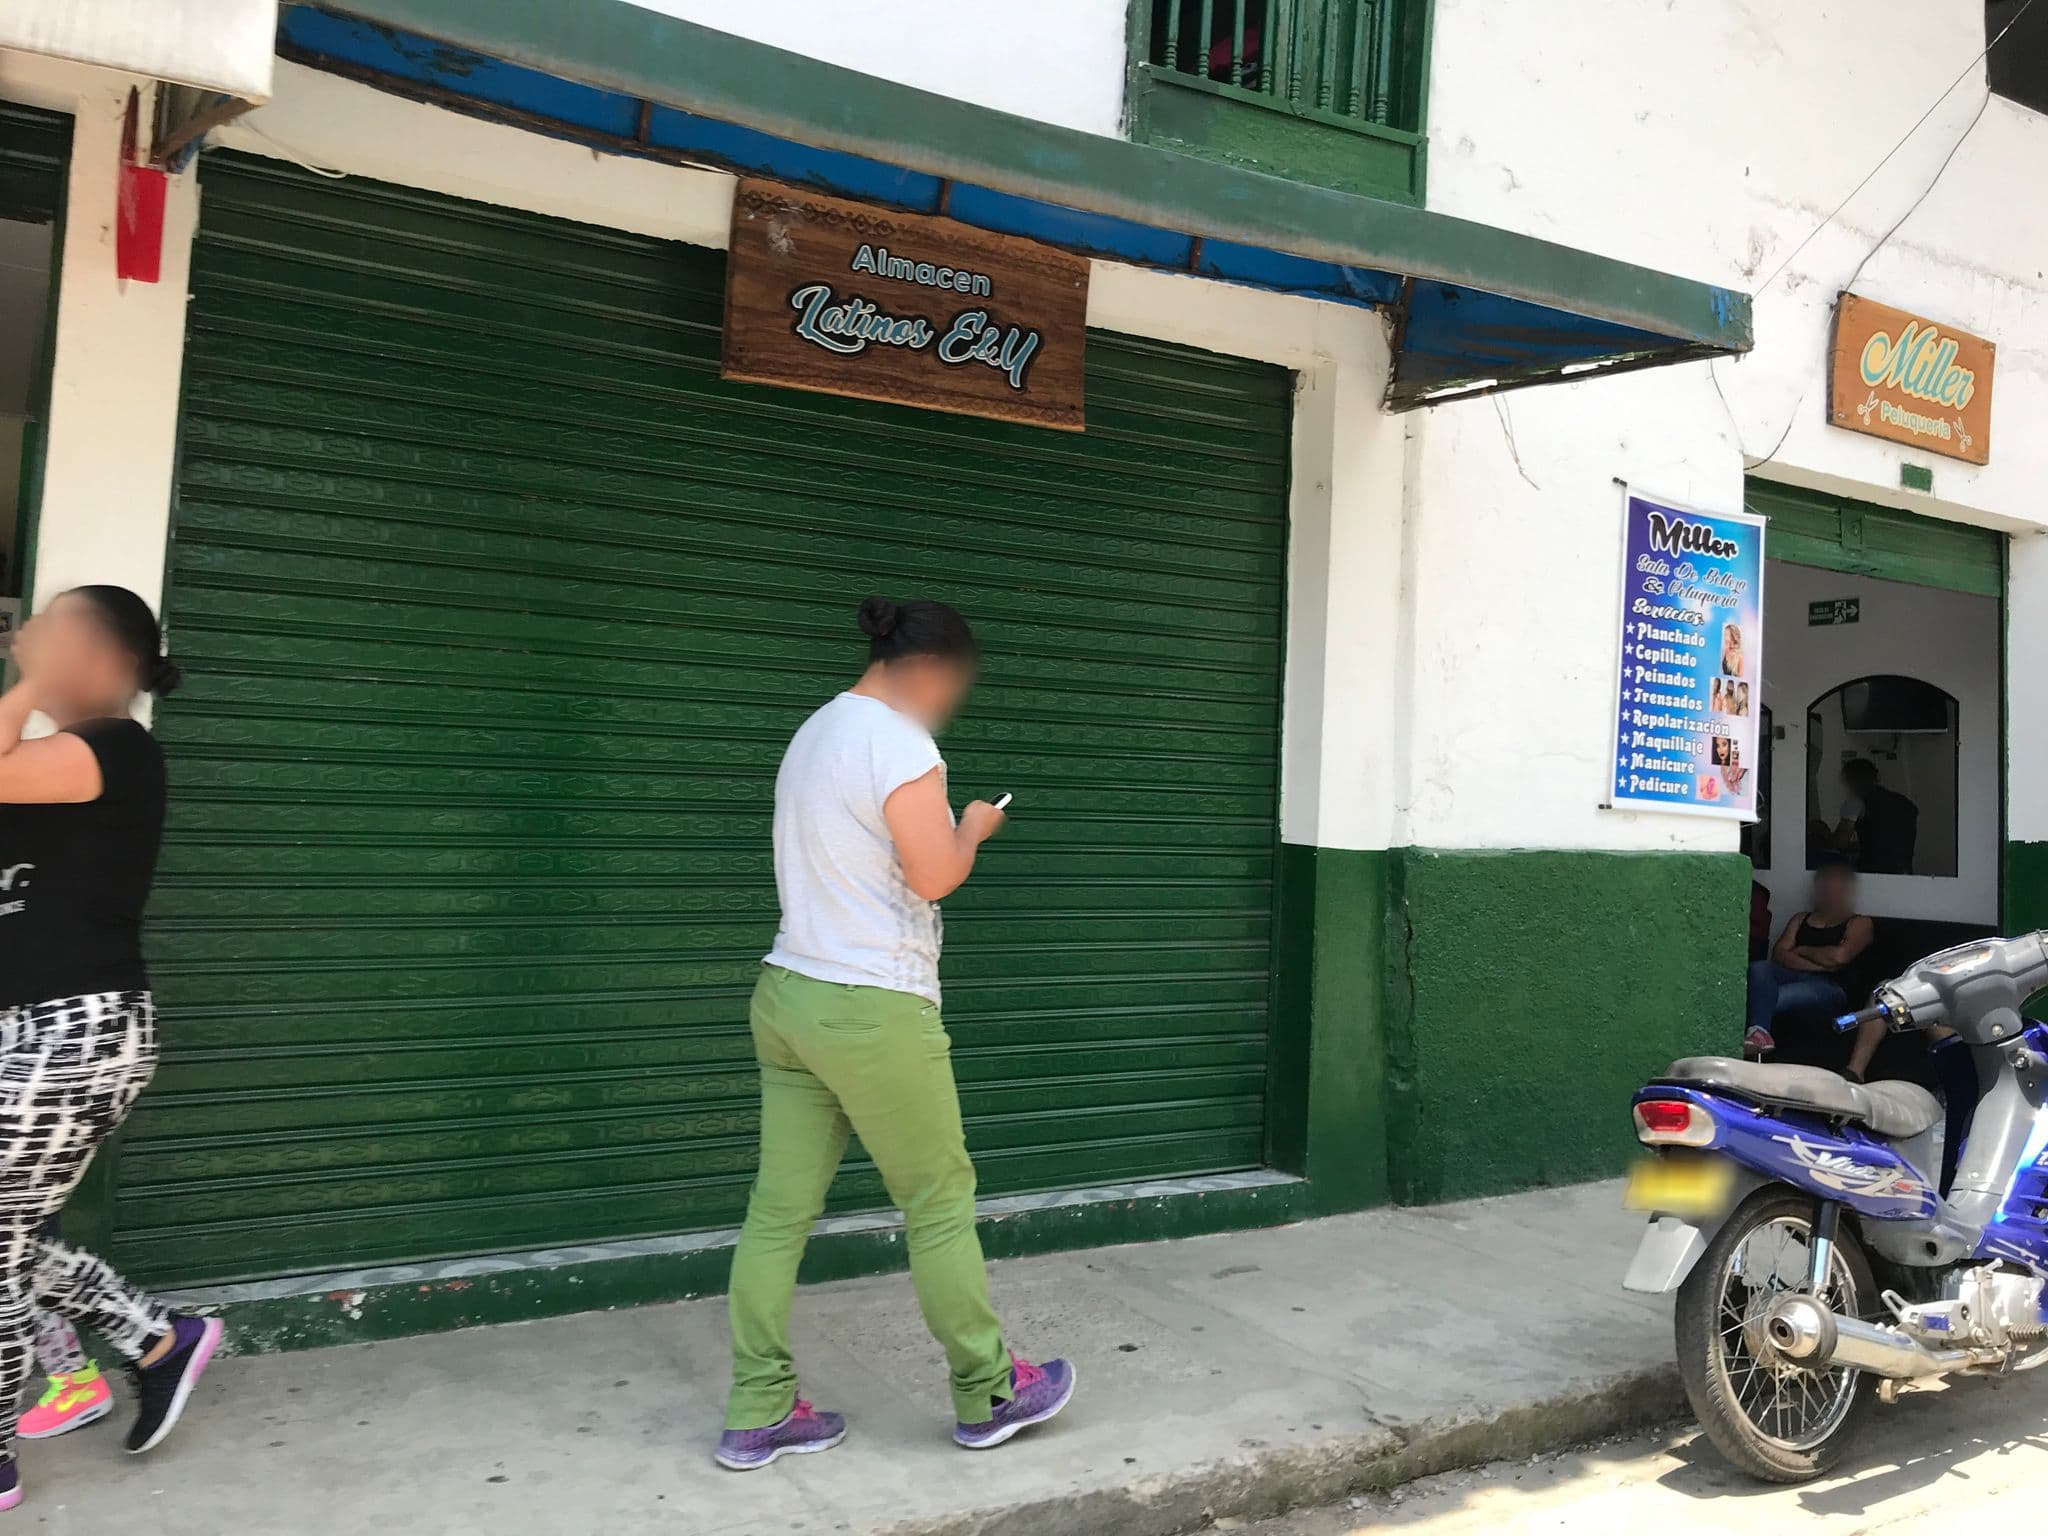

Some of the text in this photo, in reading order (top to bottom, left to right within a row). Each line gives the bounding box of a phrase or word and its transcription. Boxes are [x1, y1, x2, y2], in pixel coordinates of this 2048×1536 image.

[850, 244, 992, 298] Almacen
[791, 285, 1039, 389] Latinos E&Y
[1860, 320, 1975, 411] Miller
[1648, 511, 1739, 560] Miller
[1636, 554, 1670, 576] Sala
[1674, 562, 1699, 582] De
[1642, 576, 1665, 595] &
[1637, 622, 1706, 647] Planchado
[1635, 644, 1697, 668] Cepillado
[1635, 665, 1696, 689] Peinados
[1633, 688, 1703, 711] Trensados
[1631, 730, 1703, 754] Maquillaje
[1630, 752, 1695, 774] Manicure
[1629, 774, 1689, 795] Pedicure
